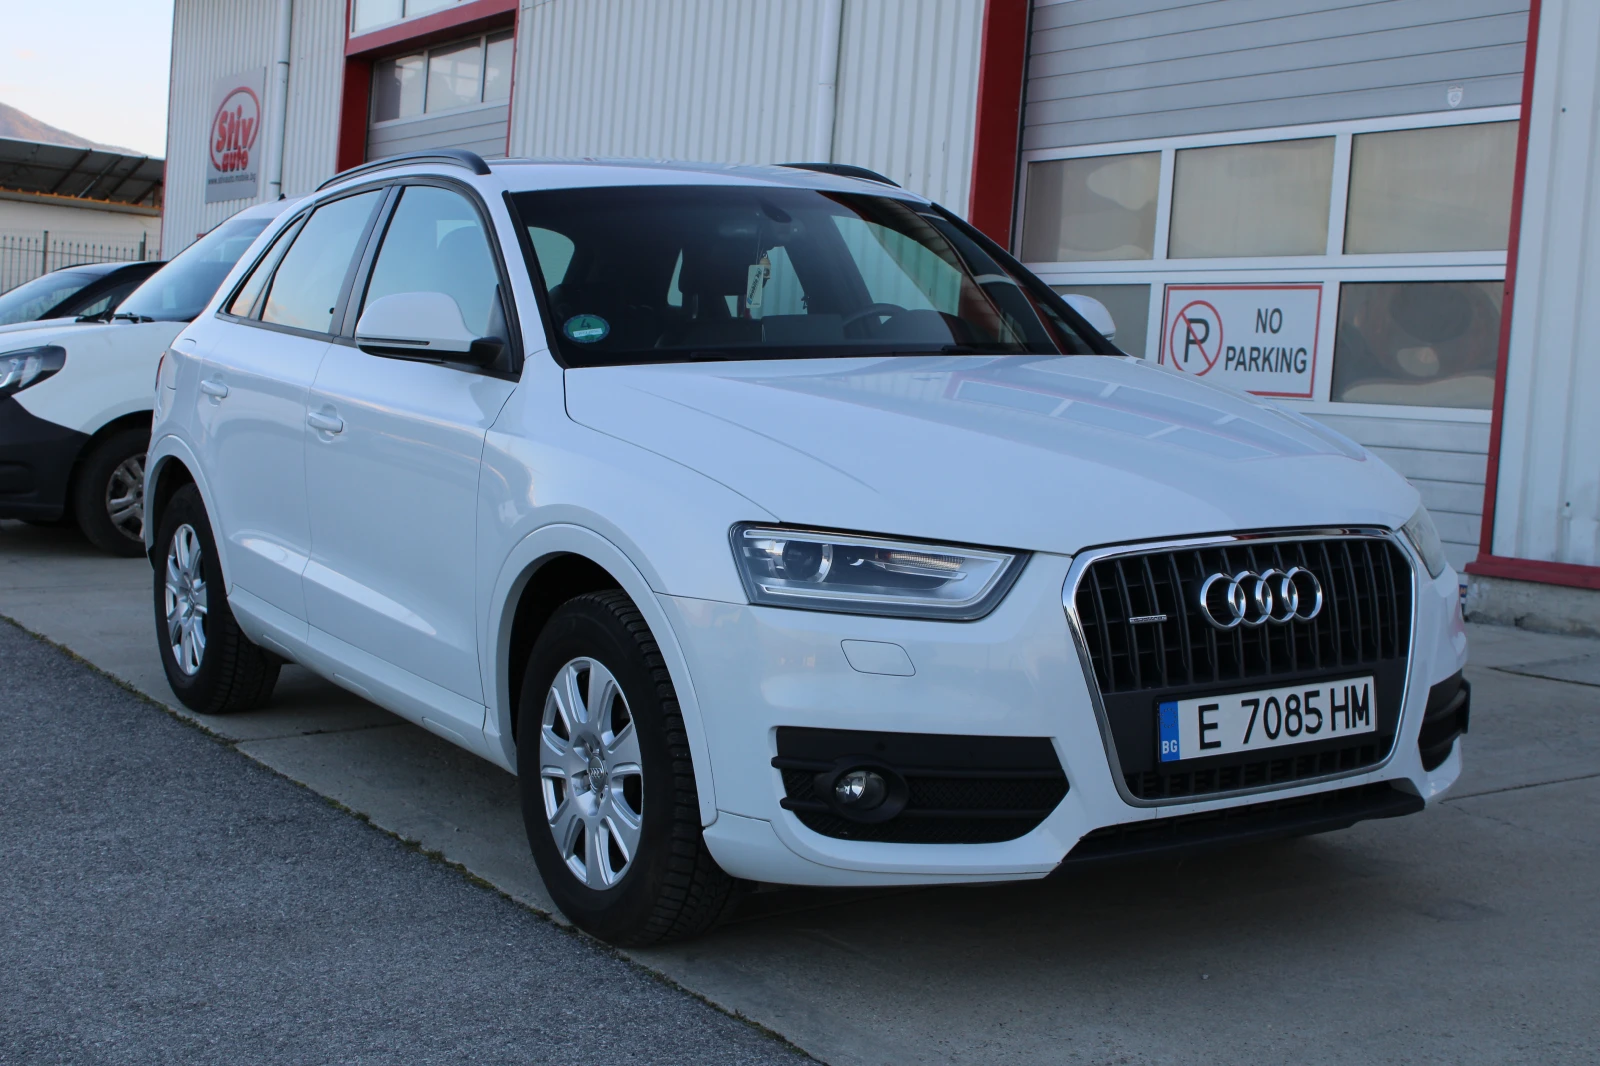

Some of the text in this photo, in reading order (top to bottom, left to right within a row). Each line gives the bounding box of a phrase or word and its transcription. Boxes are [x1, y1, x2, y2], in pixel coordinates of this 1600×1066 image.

[216, 104, 254, 152] Stiv
[222, 146, 249, 172] auto
[1255, 307, 1283, 334] NO
[1184, 318, 1210, 363] P
[1224, 346, 1307, 374] PARKING
[1198, 683, 1370, 750] E 7085 HM
[1162, 739, 1178, 755] BG
